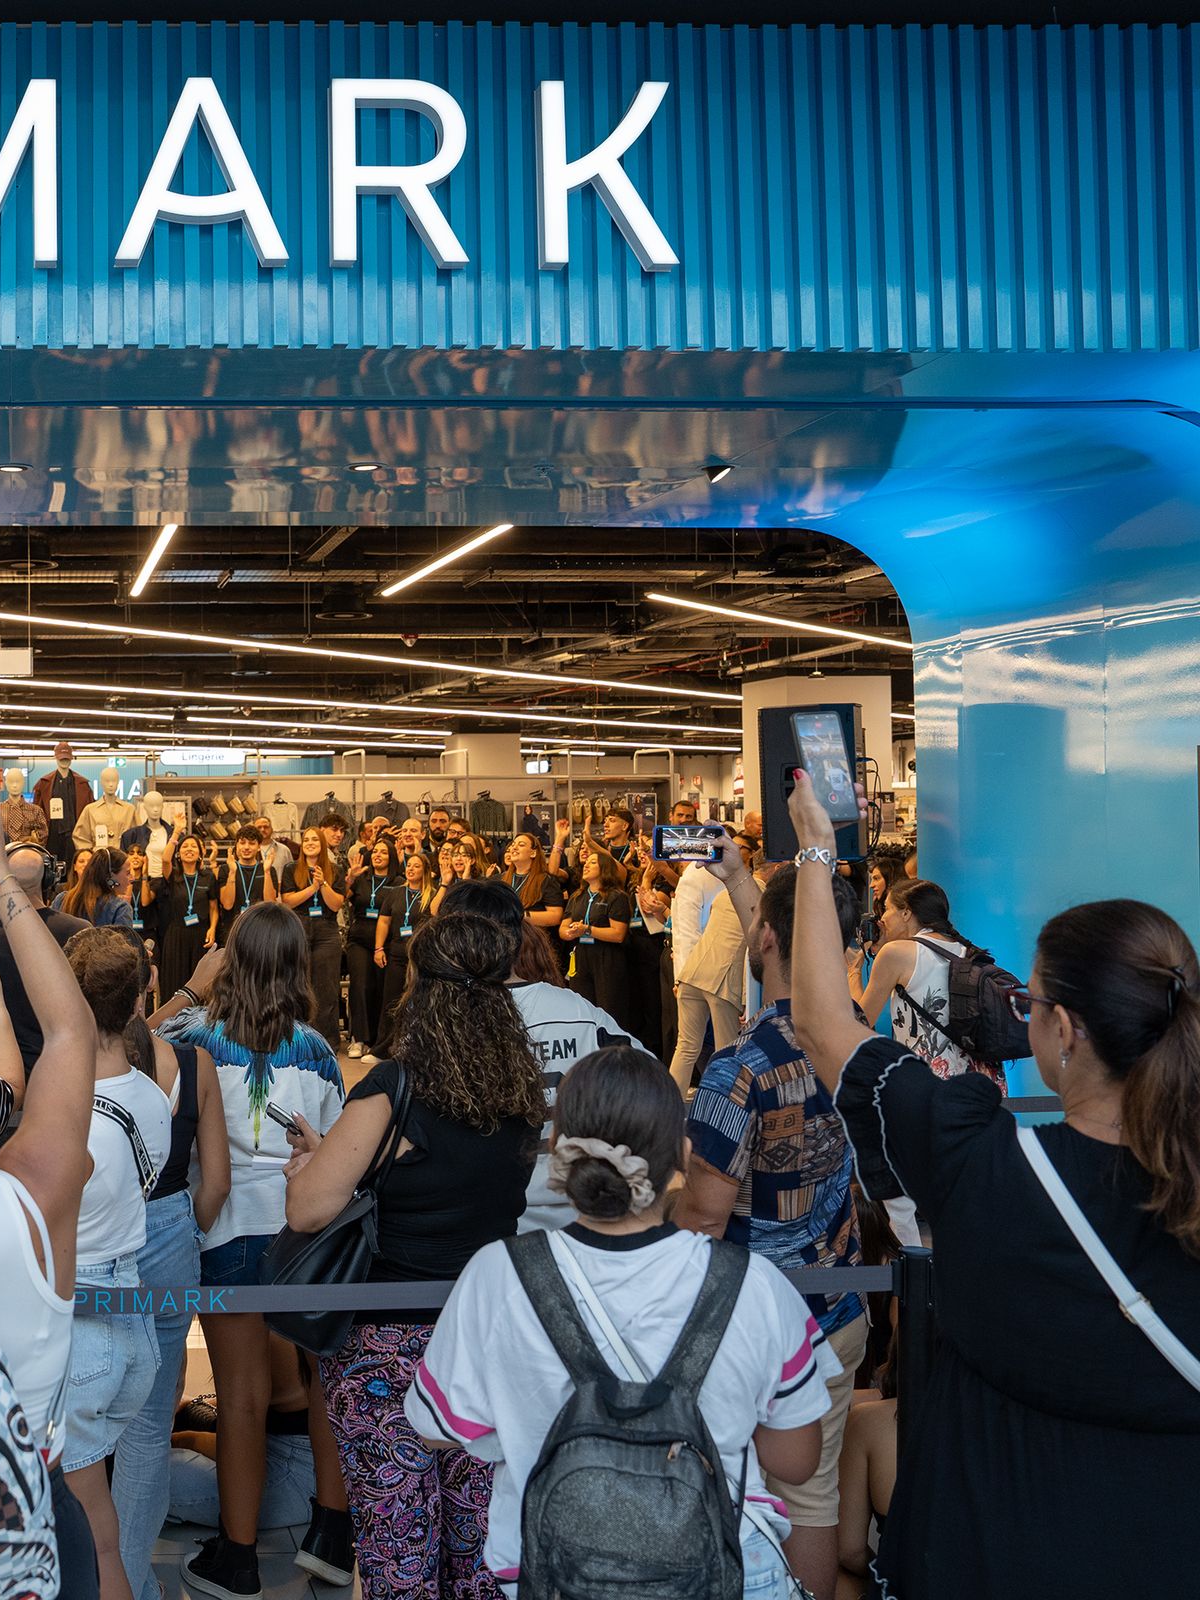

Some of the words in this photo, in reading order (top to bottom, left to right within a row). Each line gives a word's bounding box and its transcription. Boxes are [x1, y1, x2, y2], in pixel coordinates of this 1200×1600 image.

[181, 751, 225, 764] Lingerie
[530, 1038, 577, 1061] TEAM
[74, 1289, 227, 1313] PRIMARK
